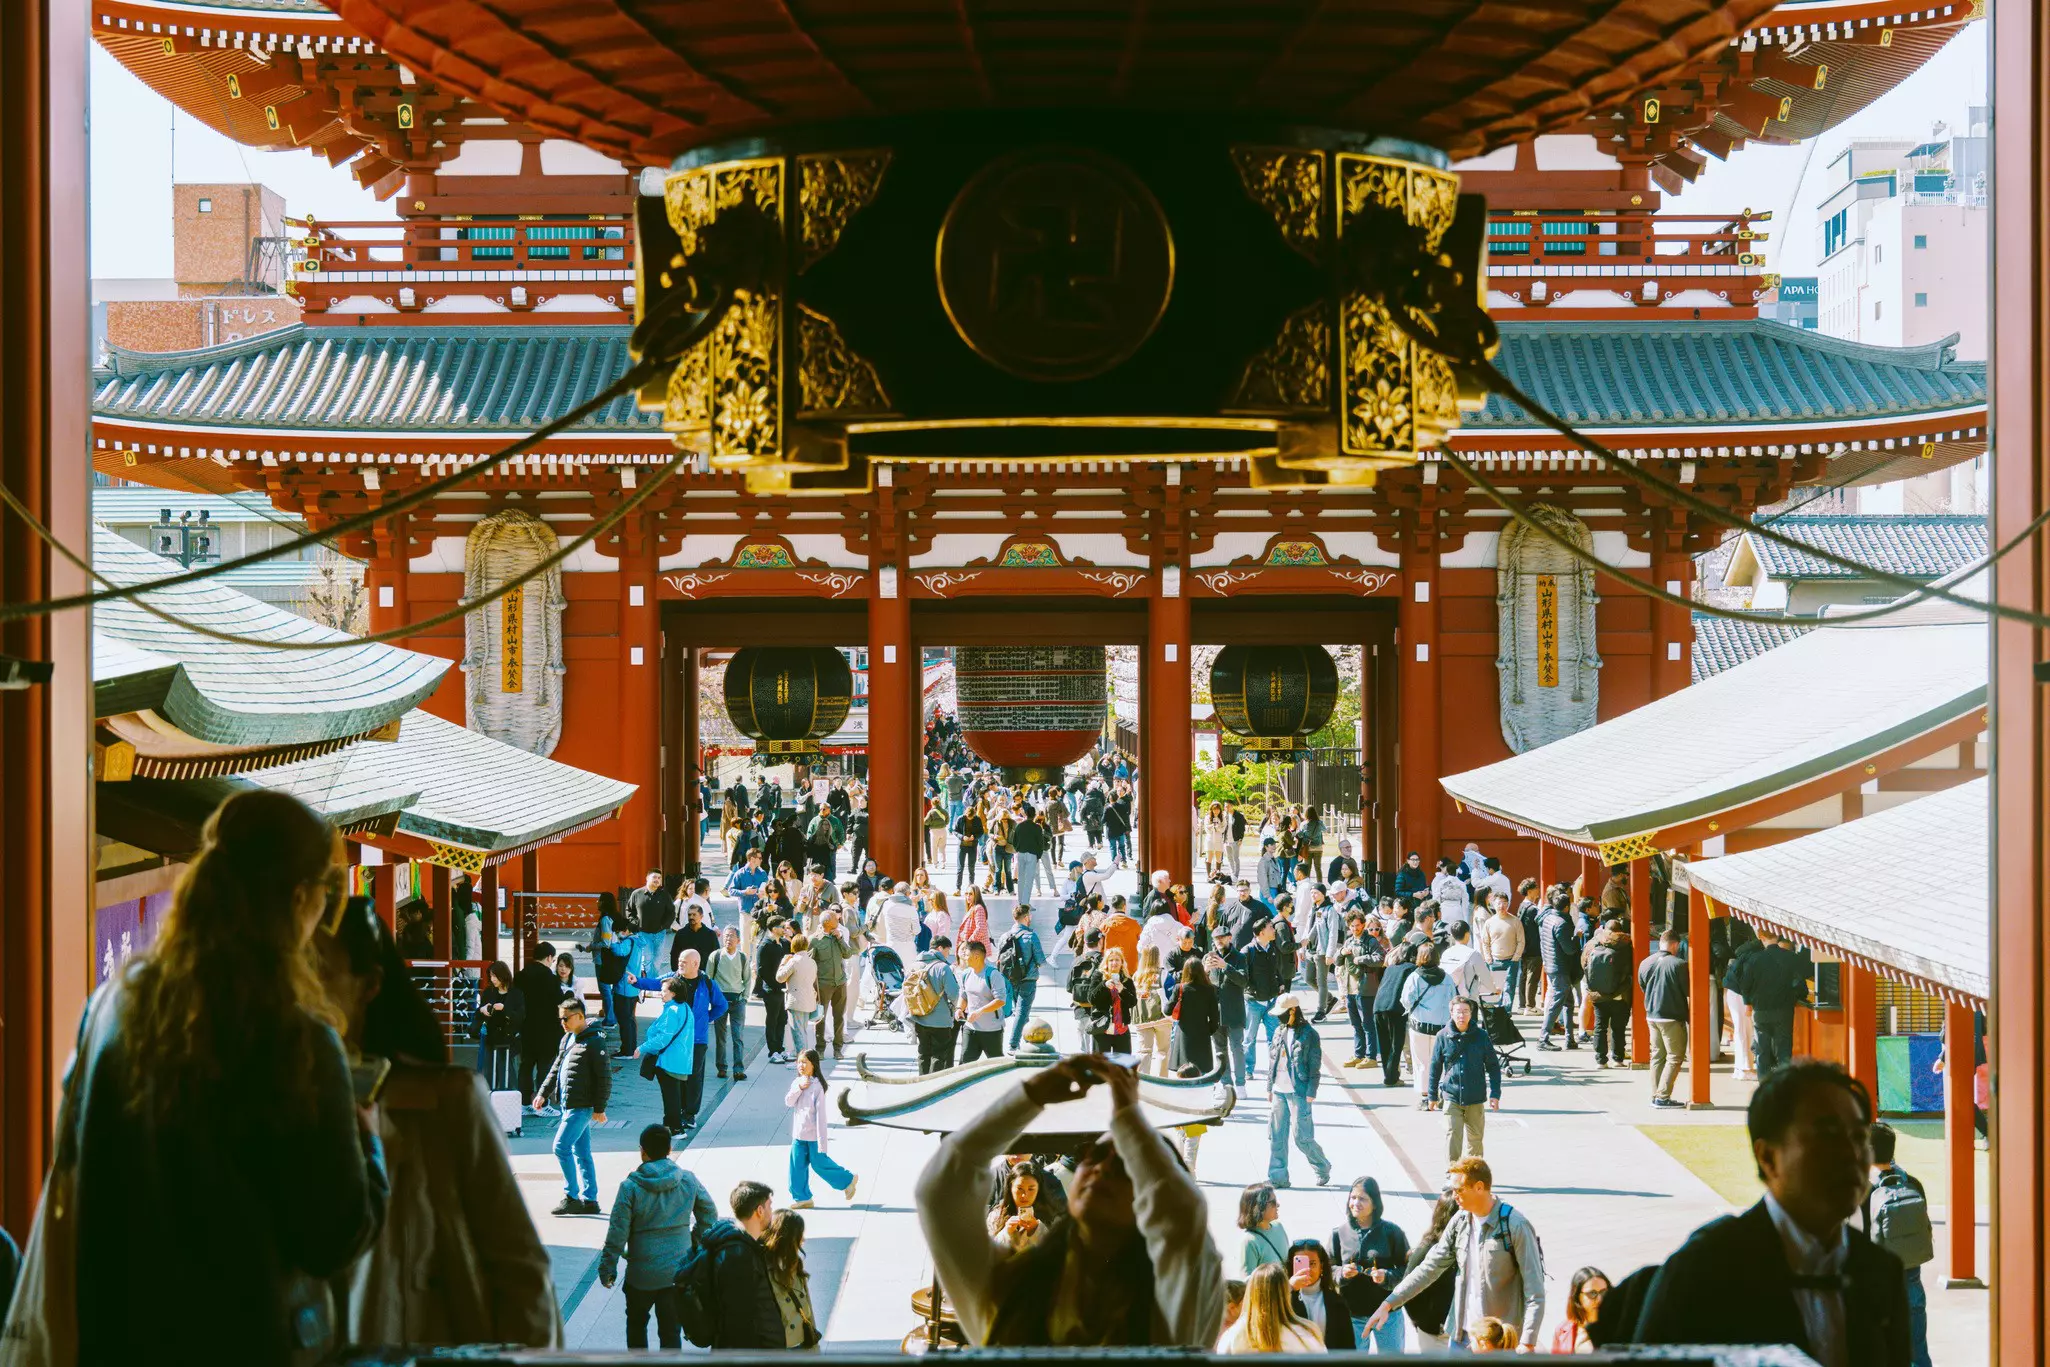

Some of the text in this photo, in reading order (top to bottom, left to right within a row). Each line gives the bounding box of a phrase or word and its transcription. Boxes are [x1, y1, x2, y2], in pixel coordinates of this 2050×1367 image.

[222, 307, 276, 324] ドレス
[1783, 285, 1805, 295] APA
[506, 594, 519, 689] 山形県村山市奉賛会
[1541, 589, 1554, 683] 山形県村山市奉賛会
